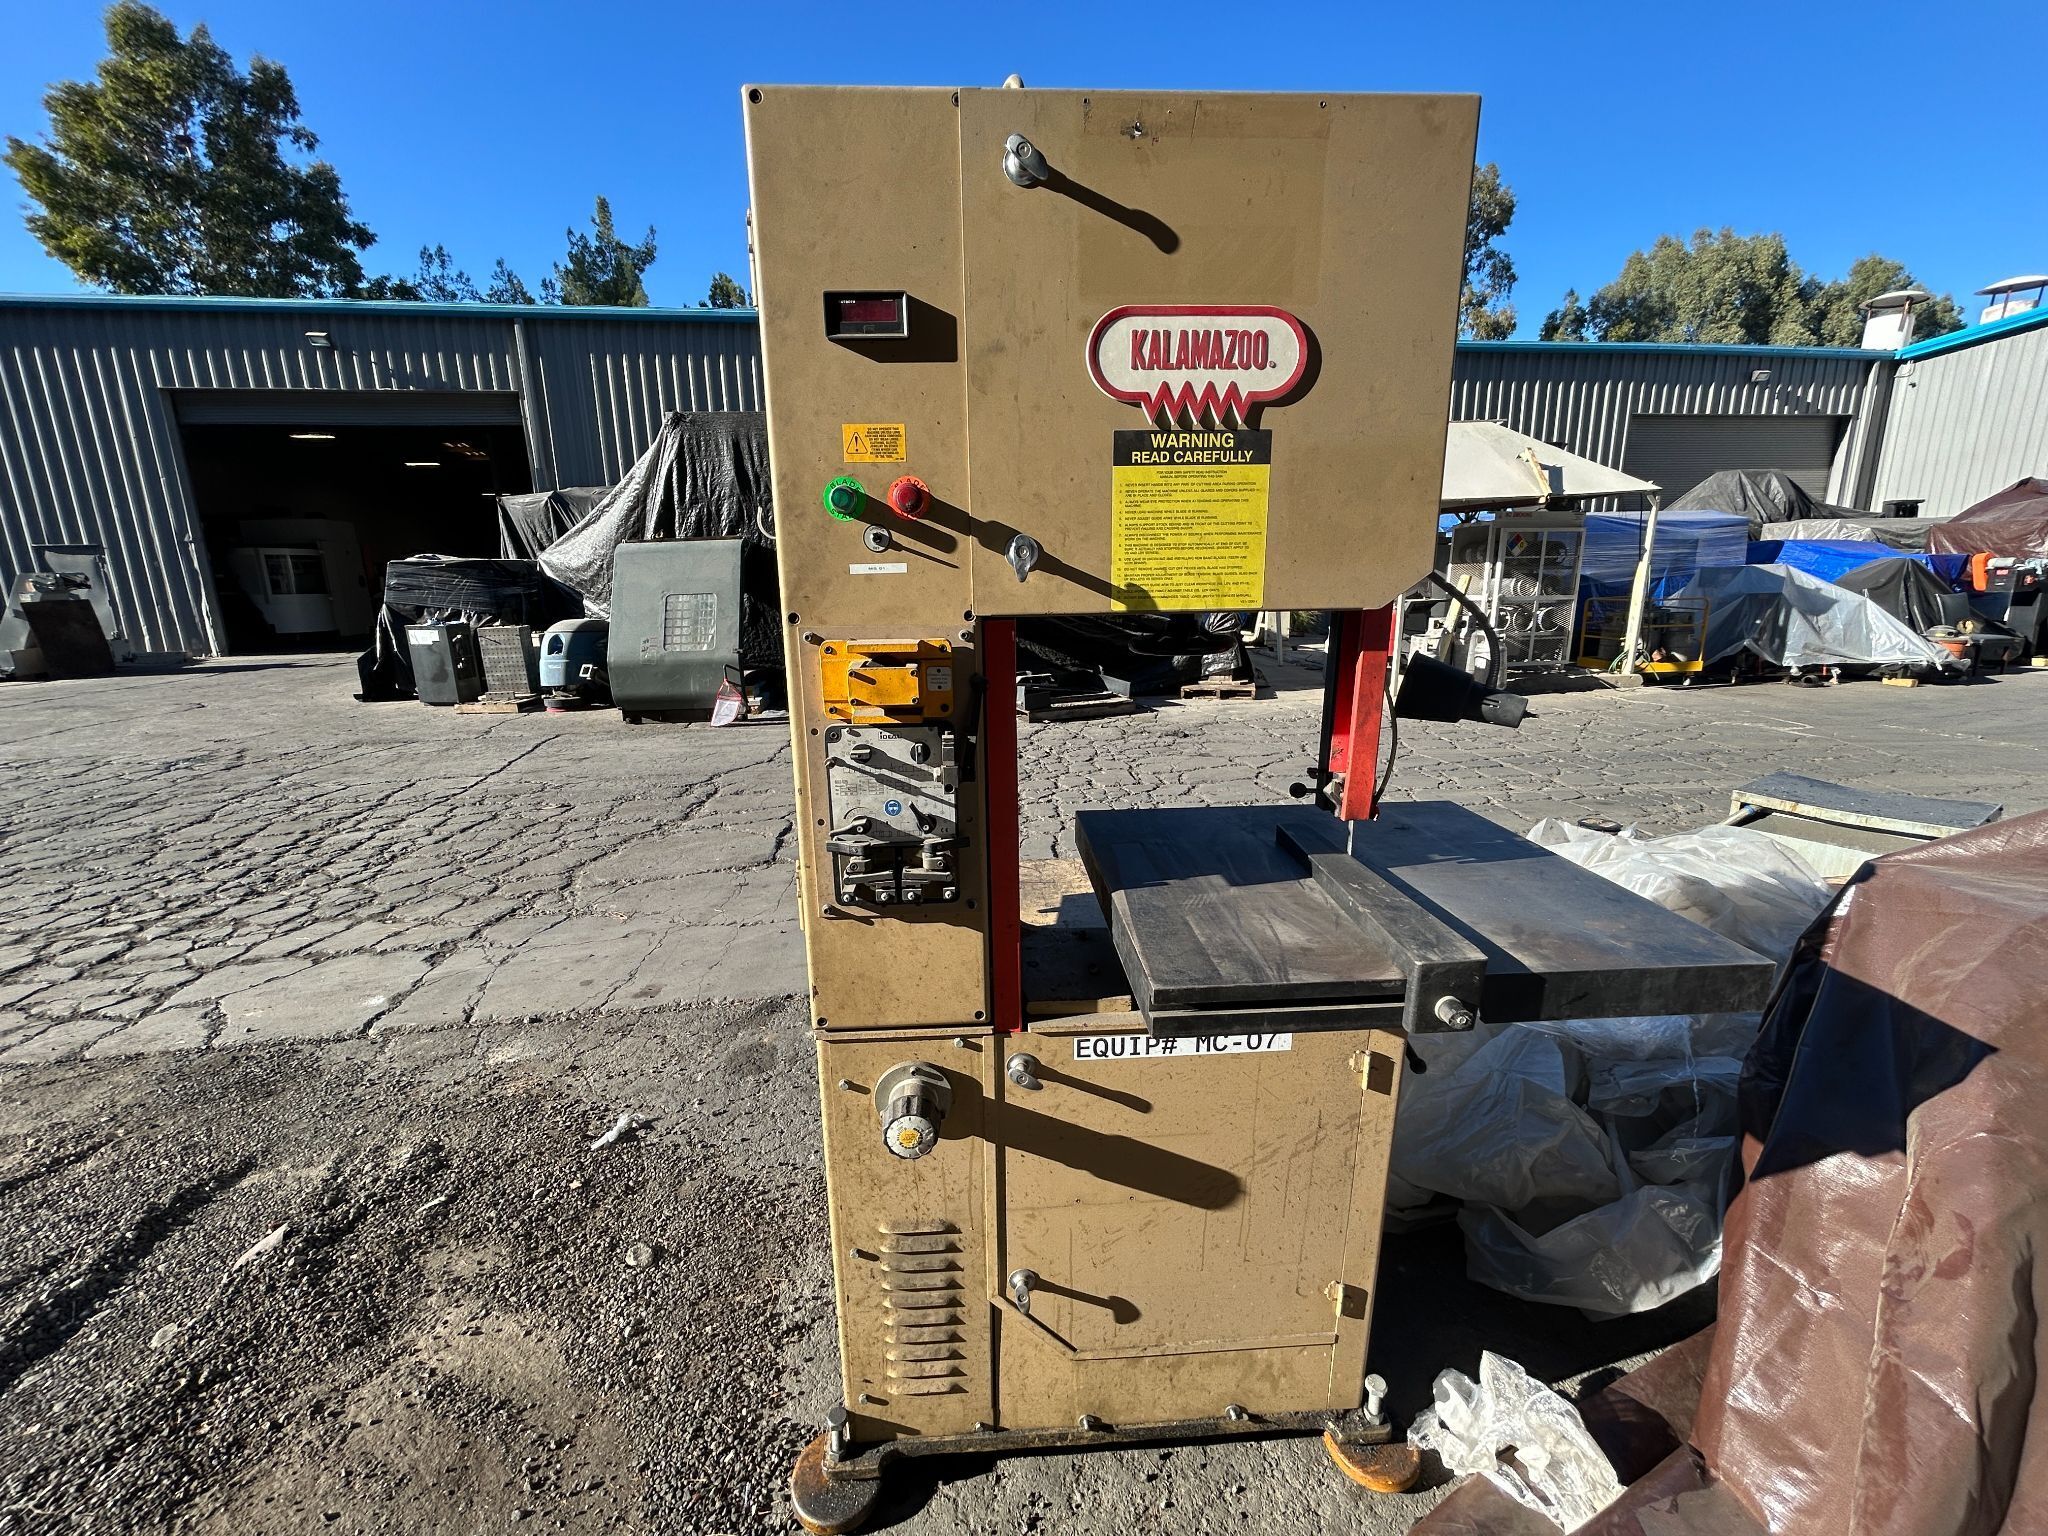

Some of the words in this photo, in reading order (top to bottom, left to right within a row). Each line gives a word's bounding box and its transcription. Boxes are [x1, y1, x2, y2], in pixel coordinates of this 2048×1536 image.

[1131, 329, 1270, 371] KALAMAZOO
[1151, 433, 1235, 449] WARNING
[1131, 451, 1170, 464] READ
[1173, 450, 1254, 464] CAREFULLY
[1075, 1036, 1178, 1058] EQUIP#
